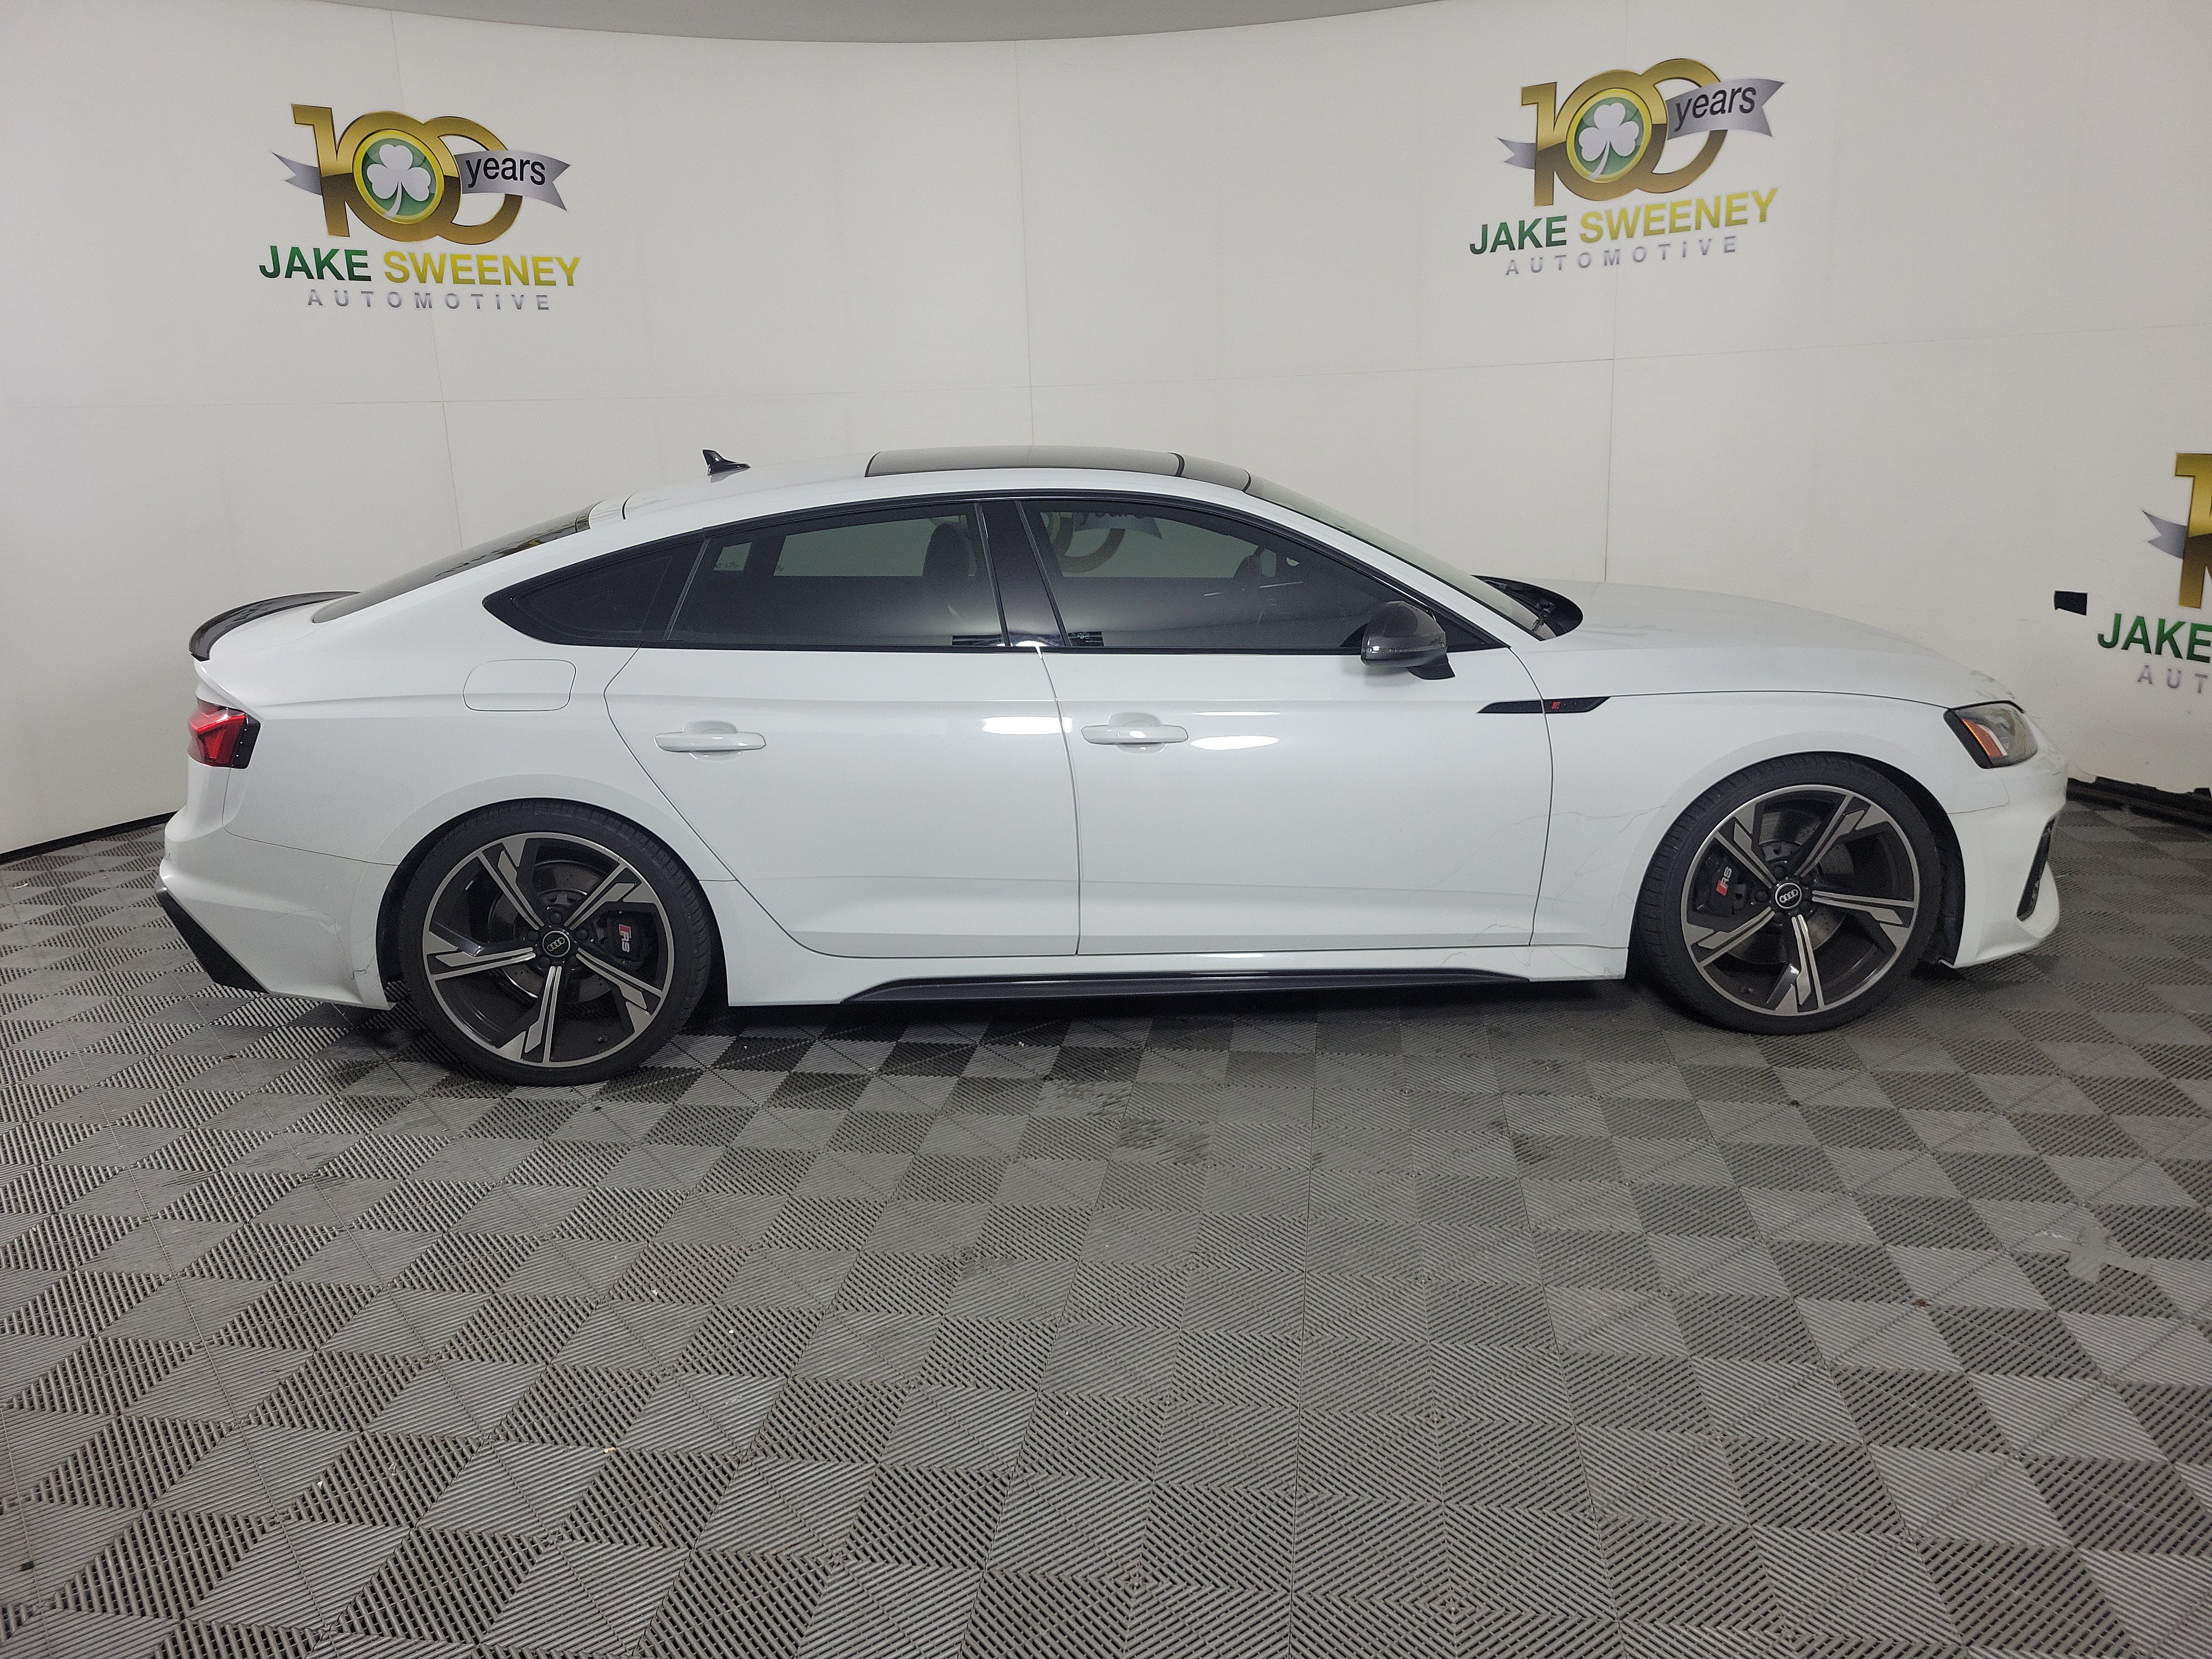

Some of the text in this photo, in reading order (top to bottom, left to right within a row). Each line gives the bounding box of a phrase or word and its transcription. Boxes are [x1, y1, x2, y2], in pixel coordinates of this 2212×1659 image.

[1521, 58, 1757, 207] 100 years
[291, 103, 546, 245] 100 years
[1469, 188, 1779, 255] JAKE SWEENEY
[259, 245, 581, 286] JAKE SWEENEY
[1505, 235, 1737, 276] AUTOMOTIVE
[307, 289, 550, 311] AUTOMOTIVE
[2097, 613, 2212, 664] JAKE
[1719, 866, 1732, 890] RS
[620, 927, 630, 953] RS
